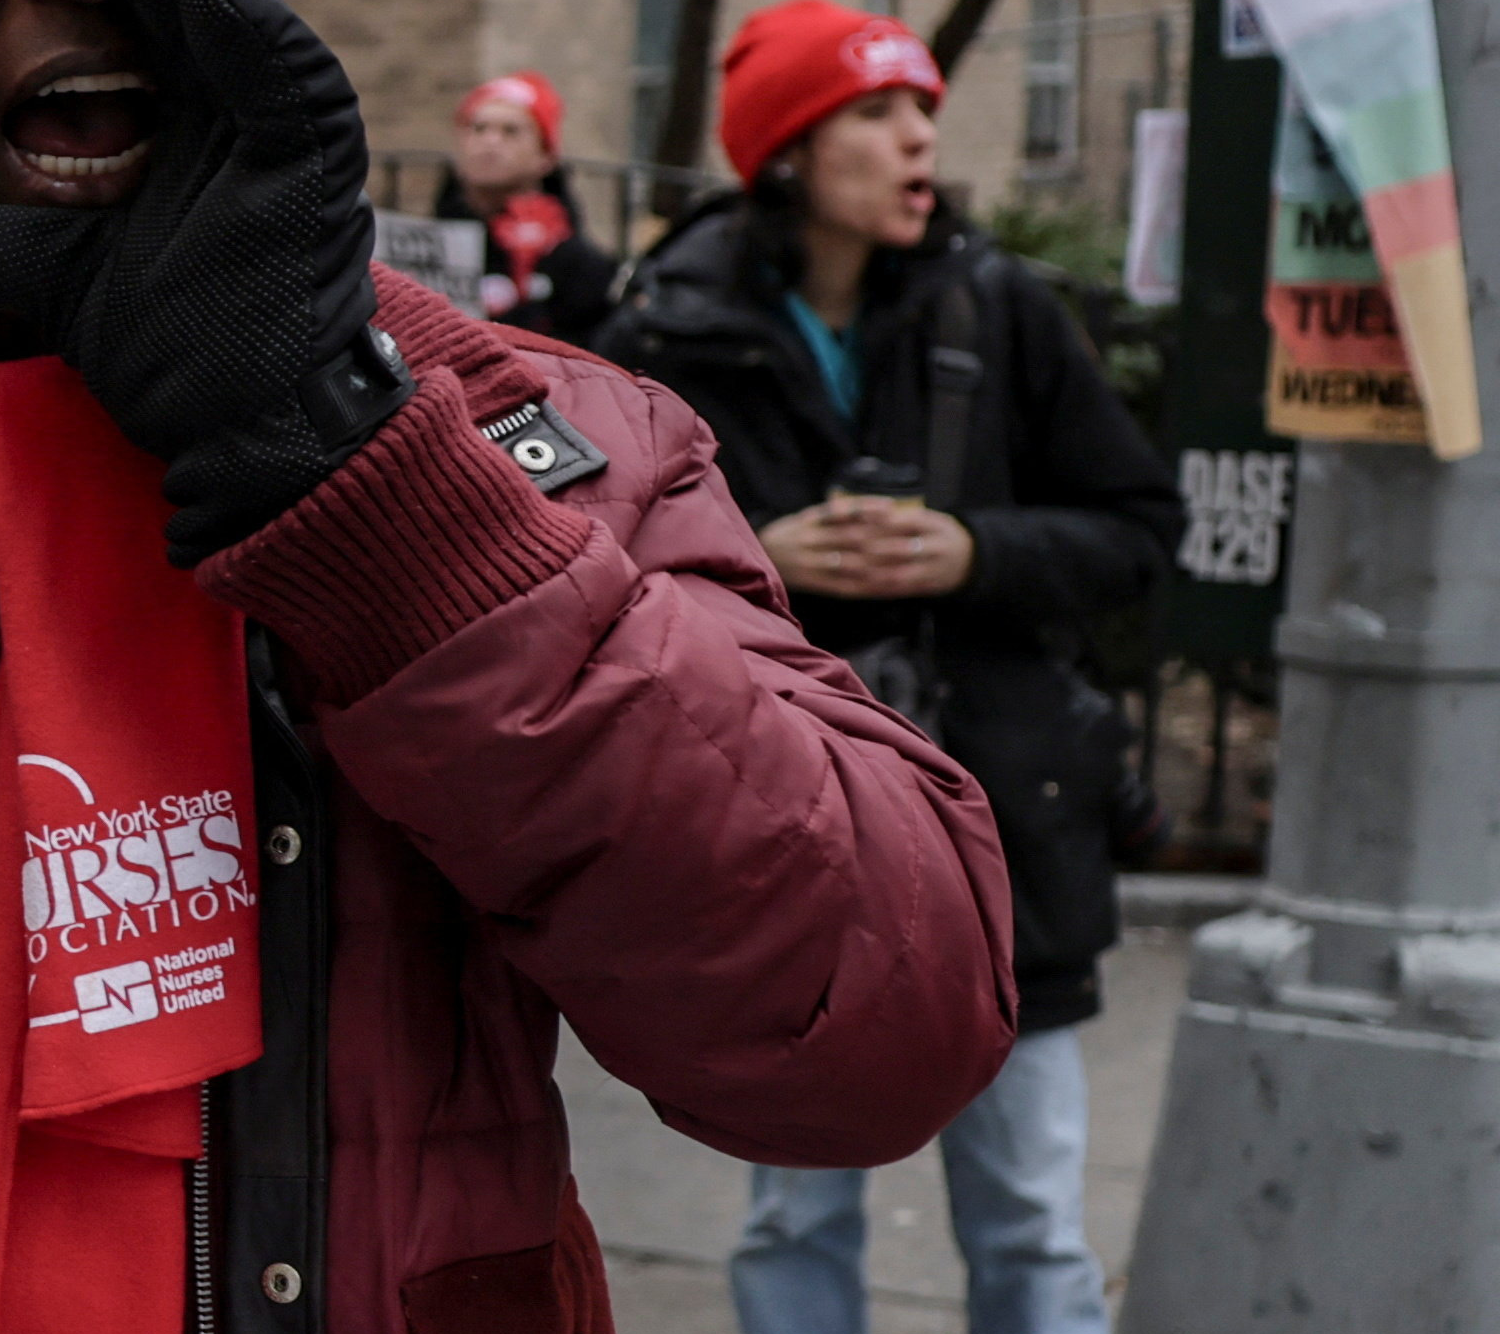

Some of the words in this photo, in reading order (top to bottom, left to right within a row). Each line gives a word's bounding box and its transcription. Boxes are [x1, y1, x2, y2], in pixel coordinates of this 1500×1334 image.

[25, 822, 96, 857] New
[98, 800, 160, 837] York
[160, 790, 233, 824] State
[22, 811, 244, 932] URSES
[28, 880, 249, 963] OCIATION
[154, 937, 235, 974] National
[158, 964, 224, 994] Nurses
[163, 981, 225, 1014] United
